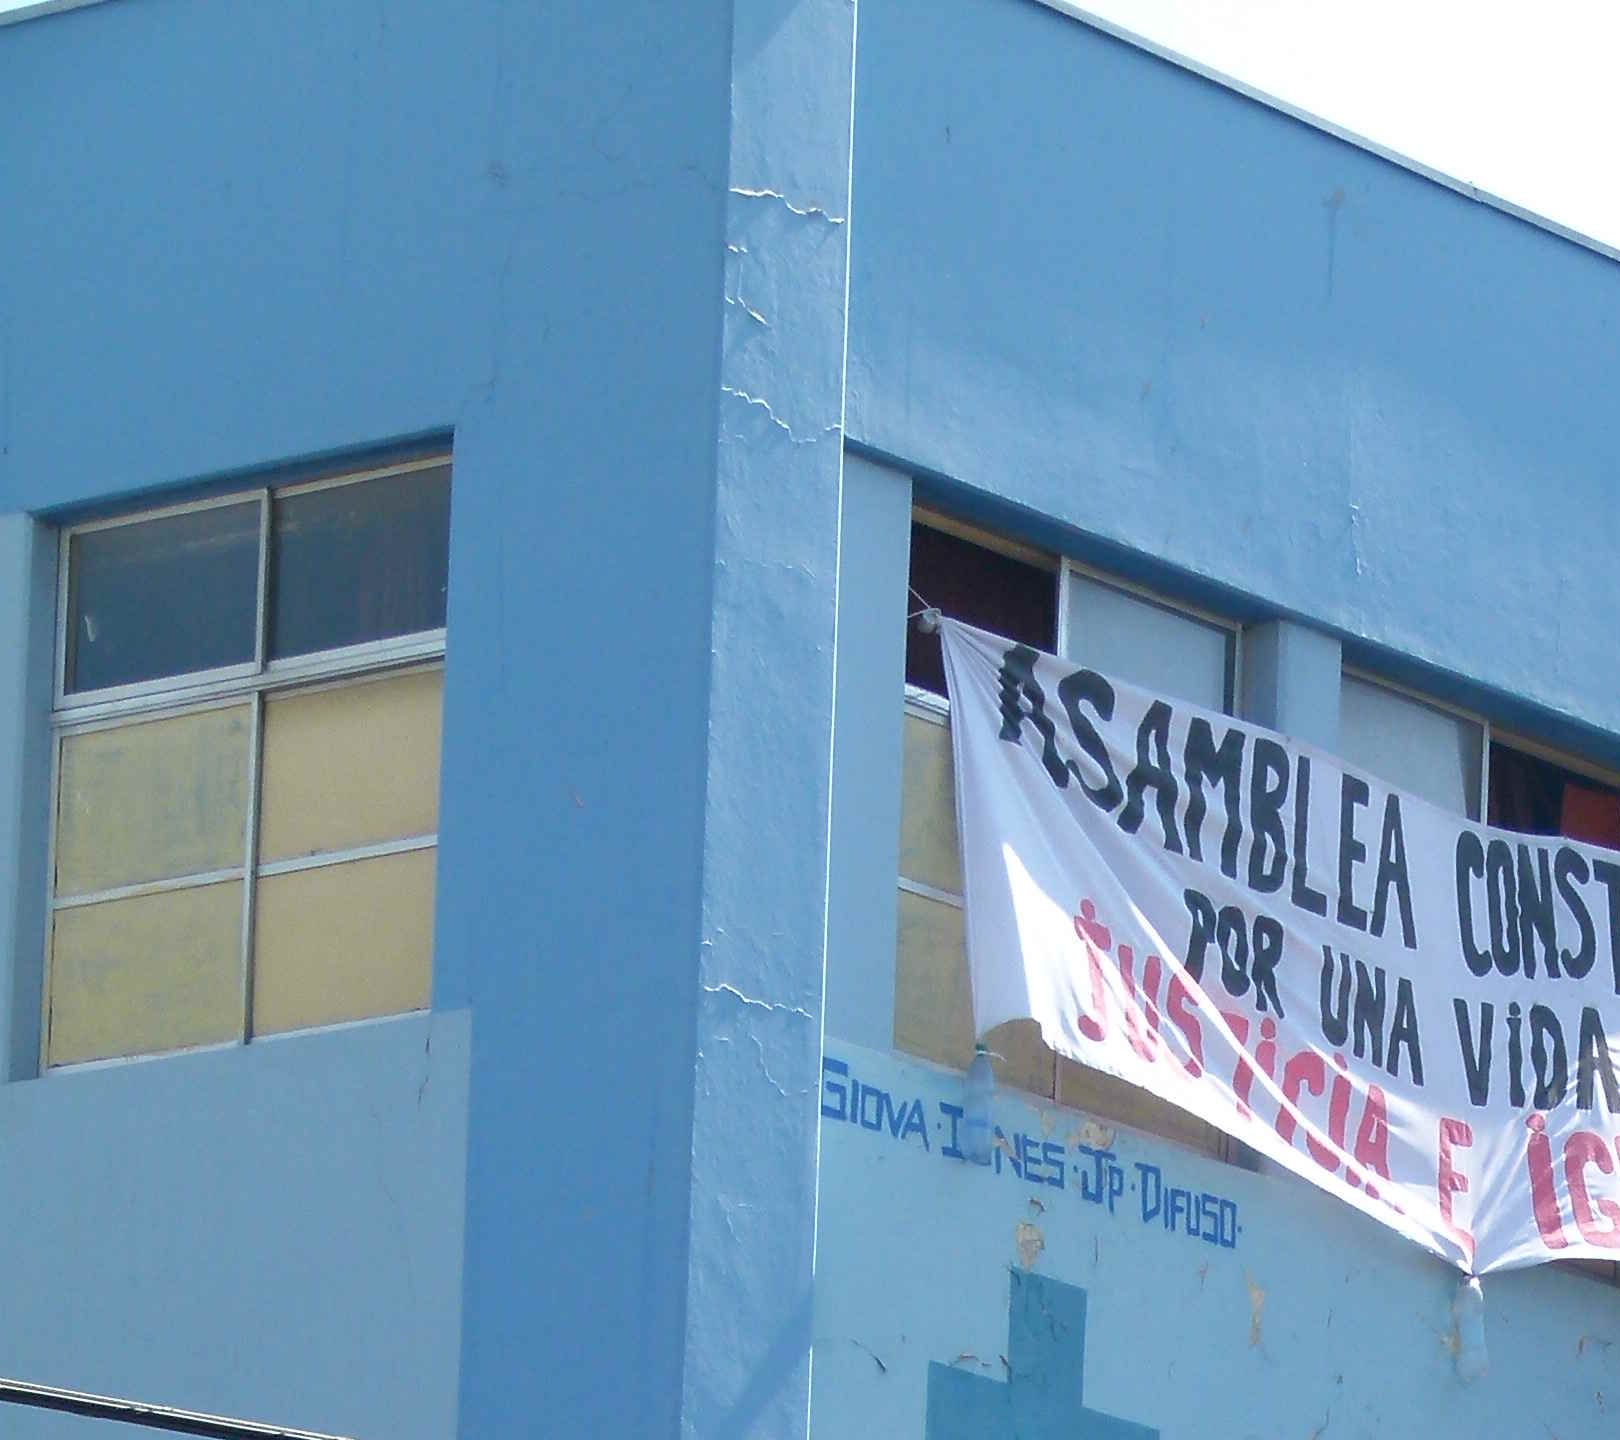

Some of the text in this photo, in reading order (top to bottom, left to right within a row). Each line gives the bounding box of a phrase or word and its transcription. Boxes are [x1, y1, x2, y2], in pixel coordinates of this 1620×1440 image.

[999, 643, 1417, 950] ASAMBLEA
[1184, 888, 1284, 1018] POR
[1320, 944, 1424, 1086] UNA
[1439, 1117, 1475, 1256] E
